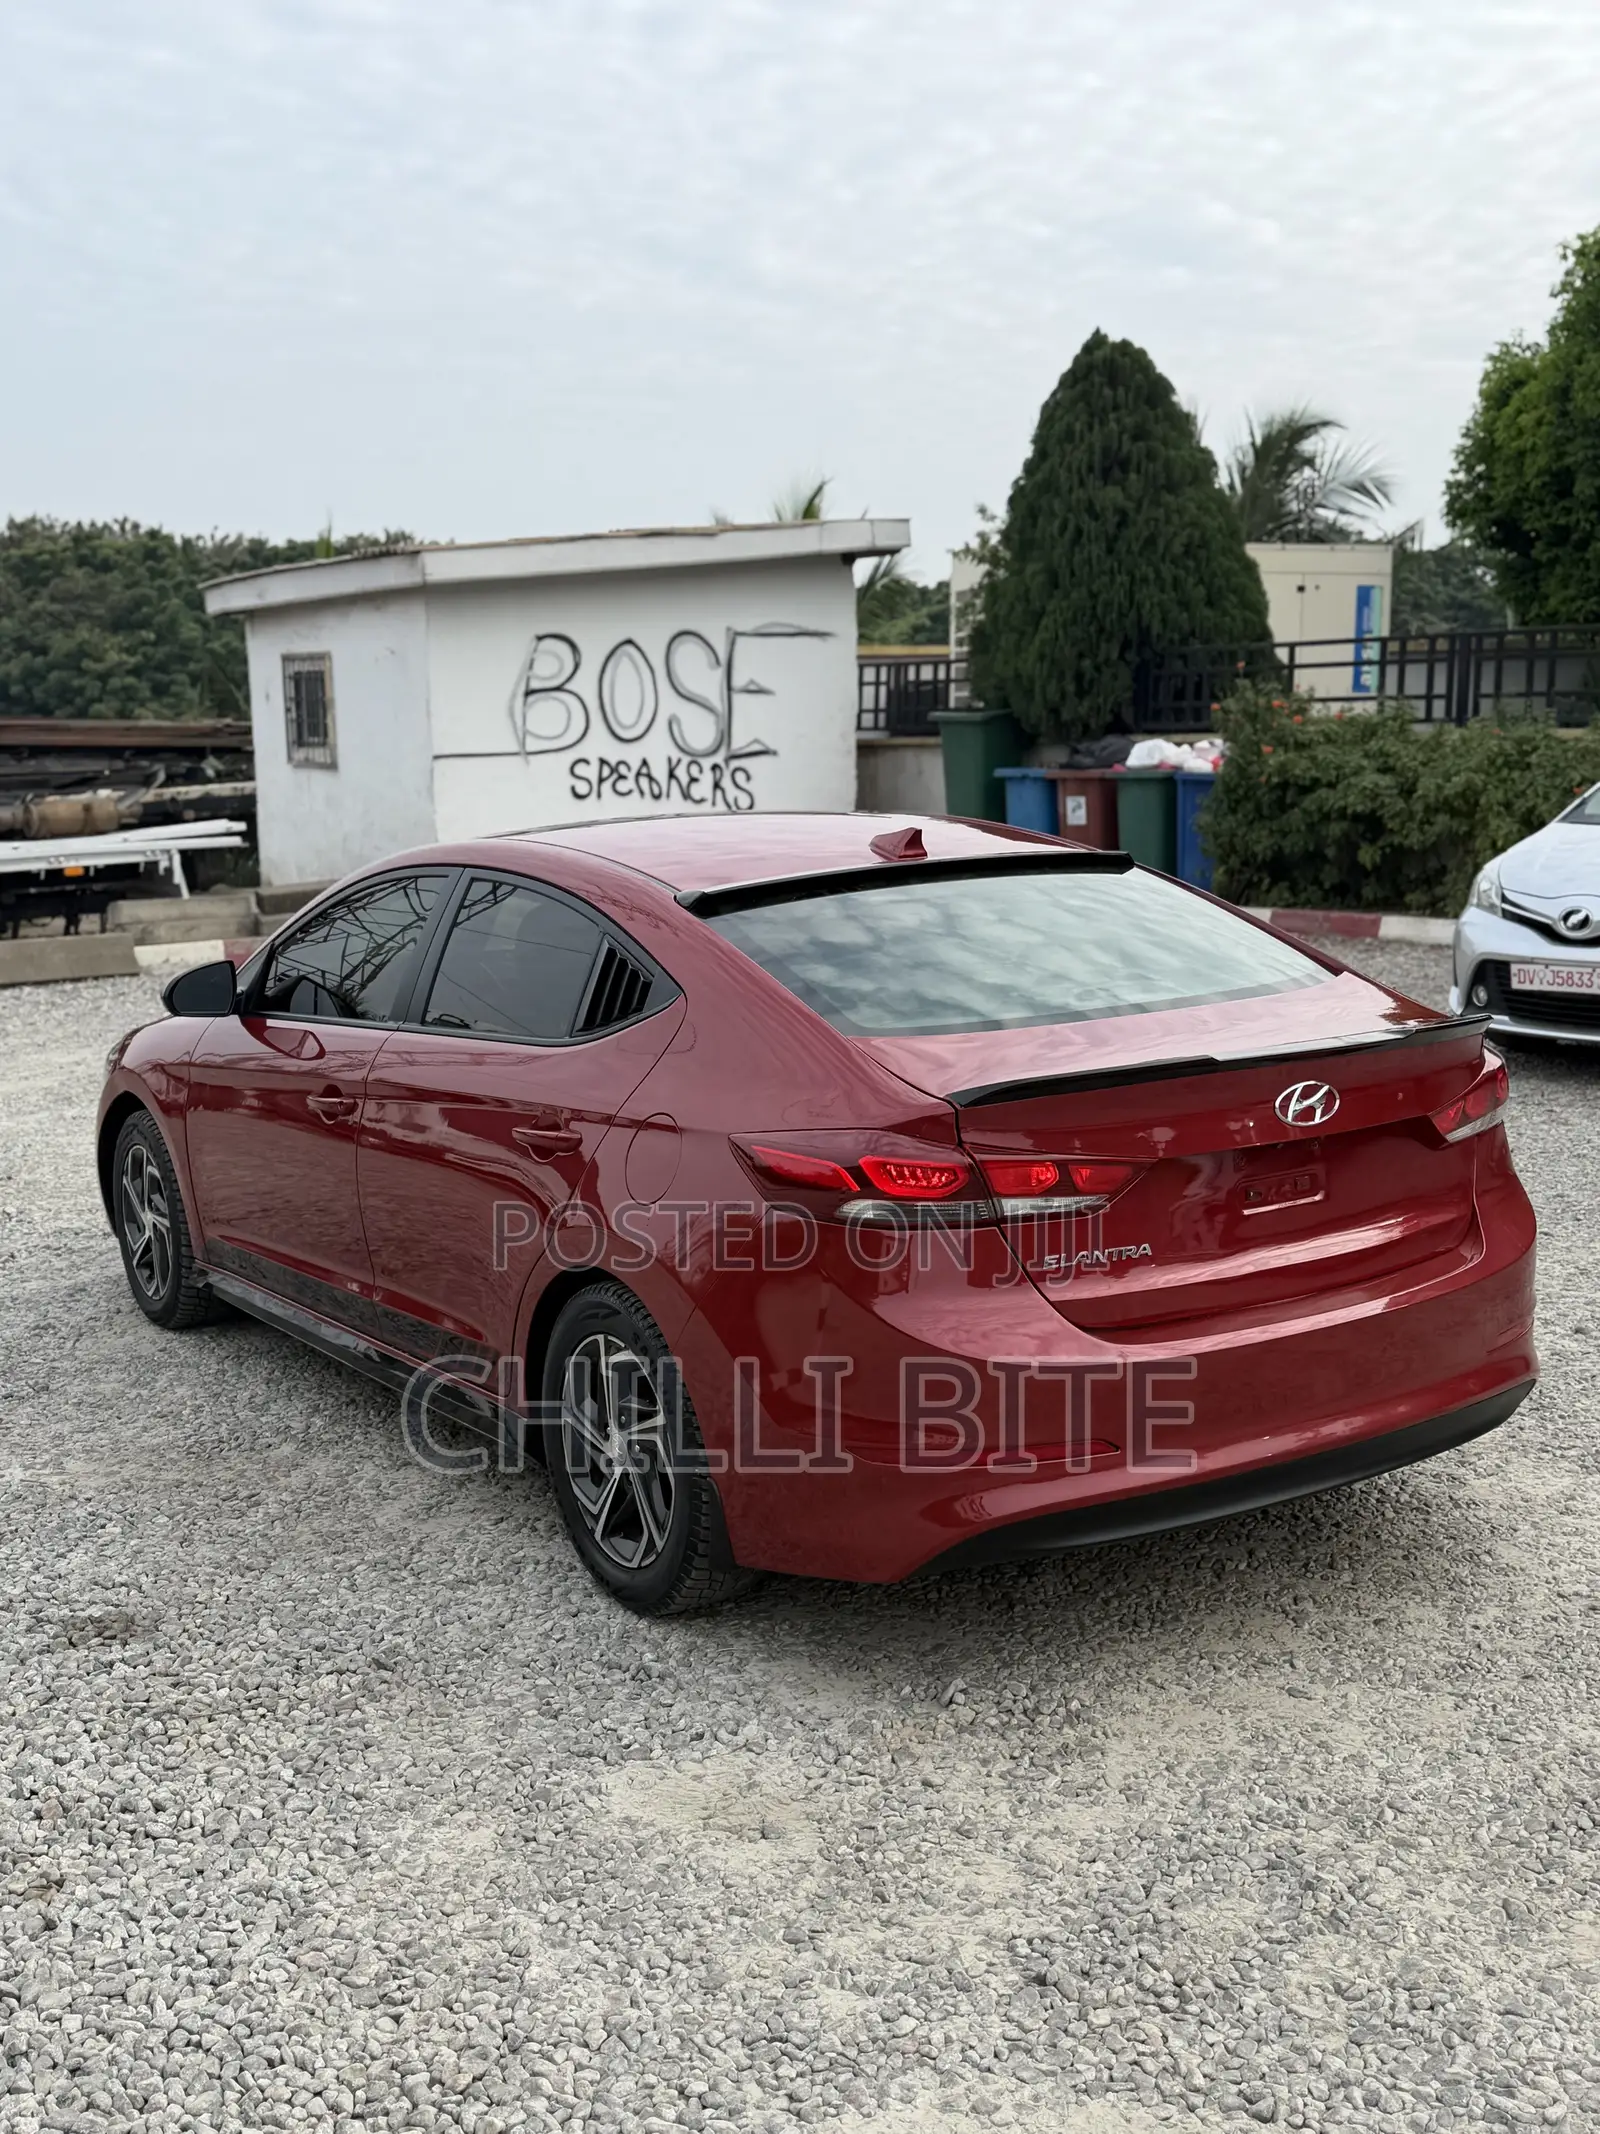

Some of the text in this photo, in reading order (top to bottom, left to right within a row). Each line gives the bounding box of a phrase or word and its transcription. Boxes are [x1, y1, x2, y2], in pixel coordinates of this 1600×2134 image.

[508, 621, 838, 769] BOSE
[569, 755, 756, 812] SPEAKERS
[1517, 968, 1536, 985] DV
[1043, 1243, 1153, 1270] ELANTRA
